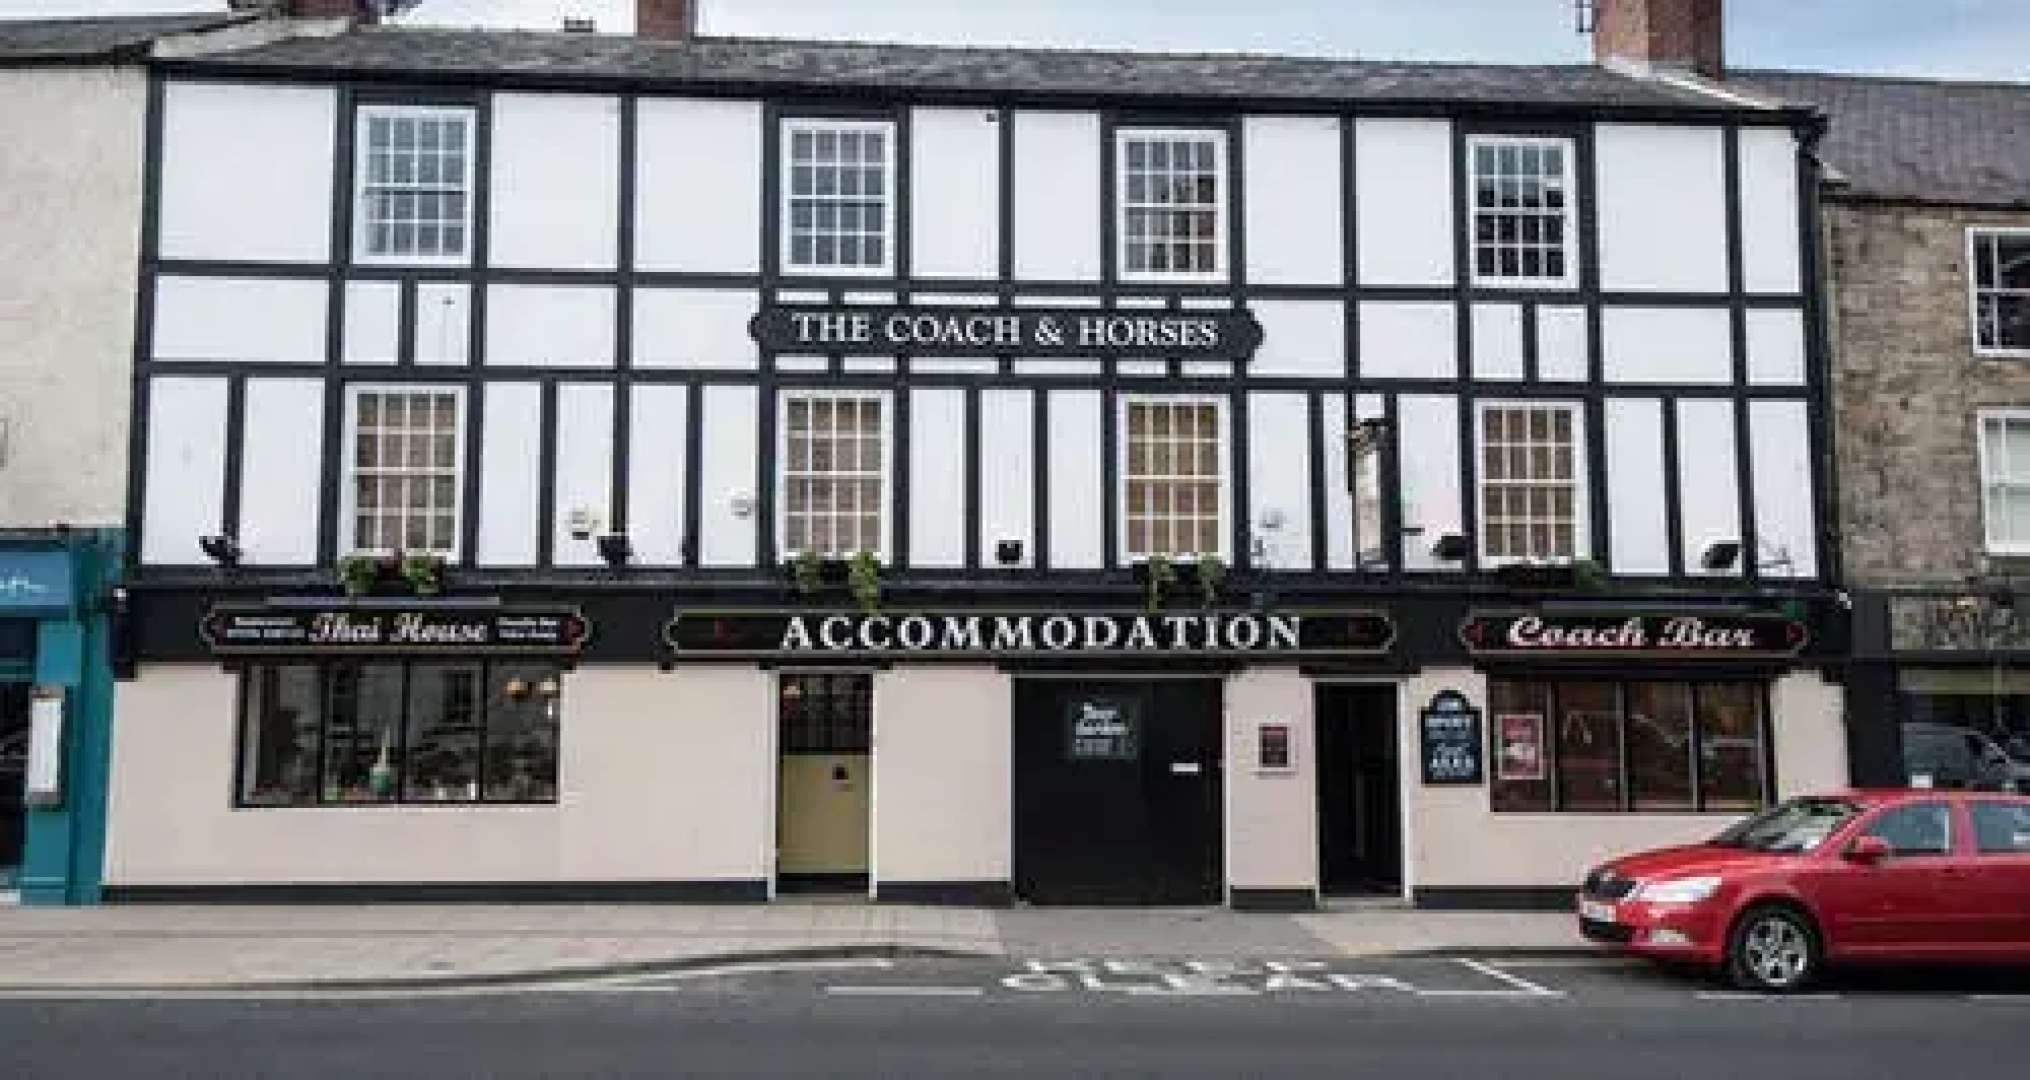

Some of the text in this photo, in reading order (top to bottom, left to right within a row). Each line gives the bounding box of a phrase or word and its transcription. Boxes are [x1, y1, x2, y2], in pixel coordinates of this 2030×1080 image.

[793, 312, 1219, 347] THE COACH & HORSES
[308, 612, 489, 642] Thai House
[780, 615, 1302, 651] ACCOMMODATION
[1508, 616, 1755, 647] Coach Bar
